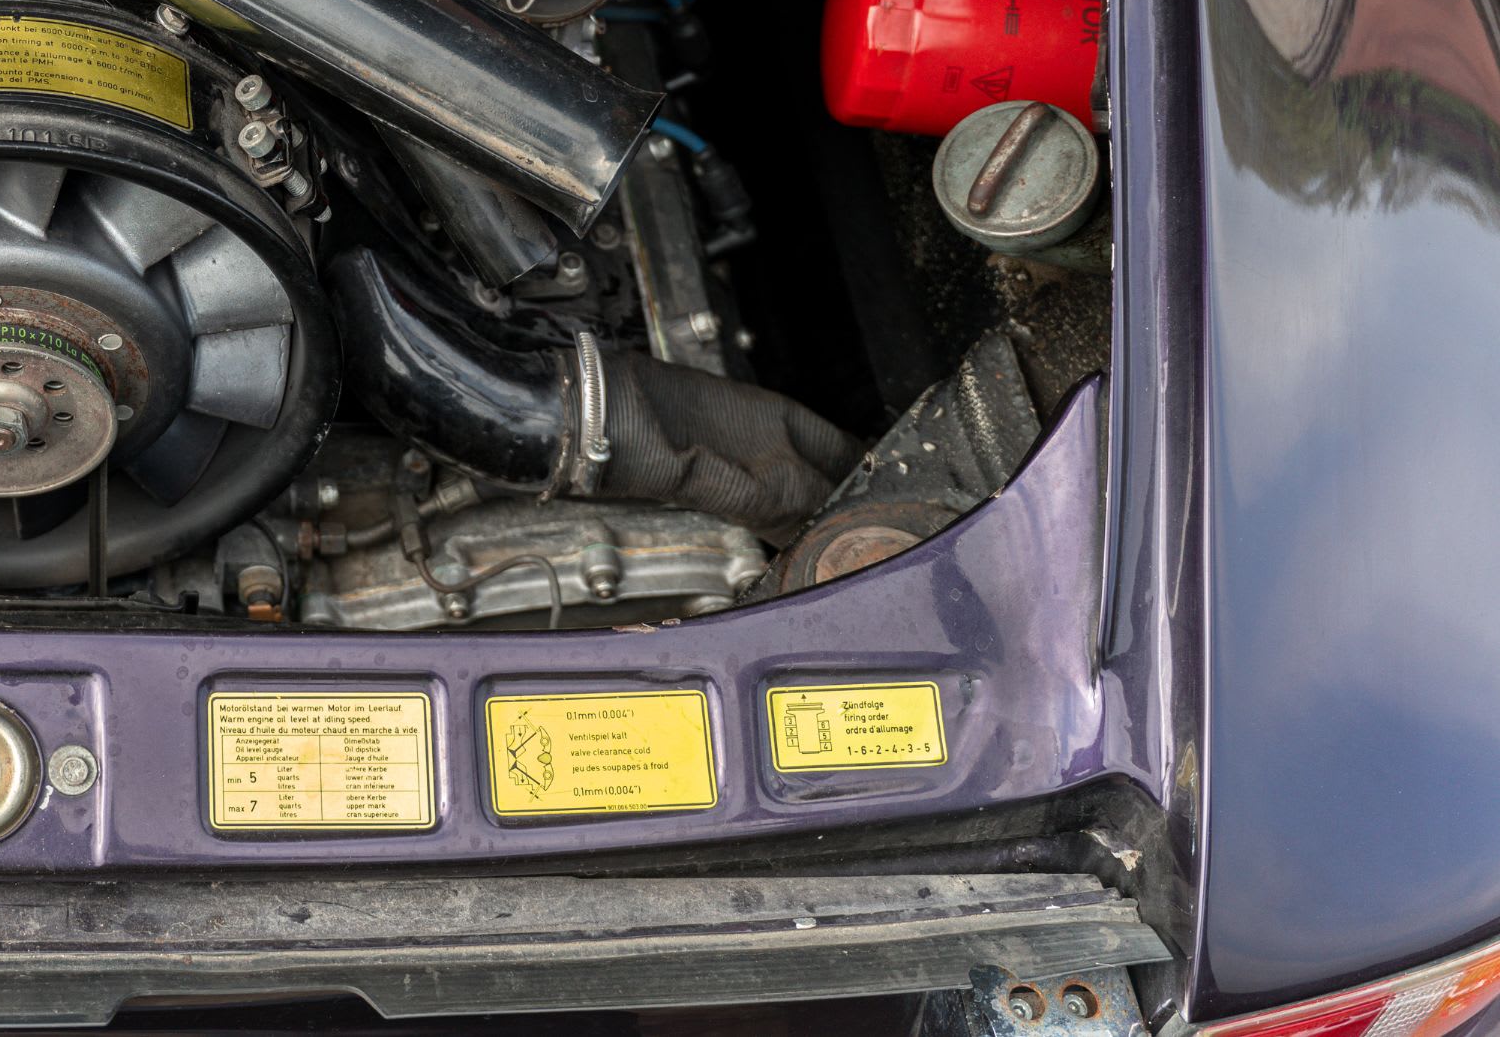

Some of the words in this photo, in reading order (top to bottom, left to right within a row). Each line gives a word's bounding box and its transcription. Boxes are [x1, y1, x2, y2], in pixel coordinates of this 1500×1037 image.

[12, 38, 42, 46] timing
[61, 42, 82, 51] 6000
[34, 51, 83, 63] l'allumage
[96, 61, 117, 71] 6000
[26, 70, 84, 82] d'accensione
[97, 80, 118, 90] 6000
[220, 704, 272, 712] Motorölstand
[328, 704, 351, 712] Motor
[842, 700, 884, 710] Zündfolge
[247, 716, 274, 724] engine
[324, 716, 346, 724] idling
[844, 714, 866, 724] firing
[868, 713, 889, 721] order
[846, 726, 867, 734] ordre
[869, 725, 914, 734] d'allumage
[568, 732, 610, 742] Ventilspiel
[611, 732, 628, 740] kalt
[570, 748, 591, 756] valve
[634, 746, 651, 754] cold
[572, 765, 584, 774] jeu
[602, 764, 640, 772] soupapes
[650, 762, 669, 770] froid
[250, 772, 257, 784] 5
[250, 800, 258, 812] 7
